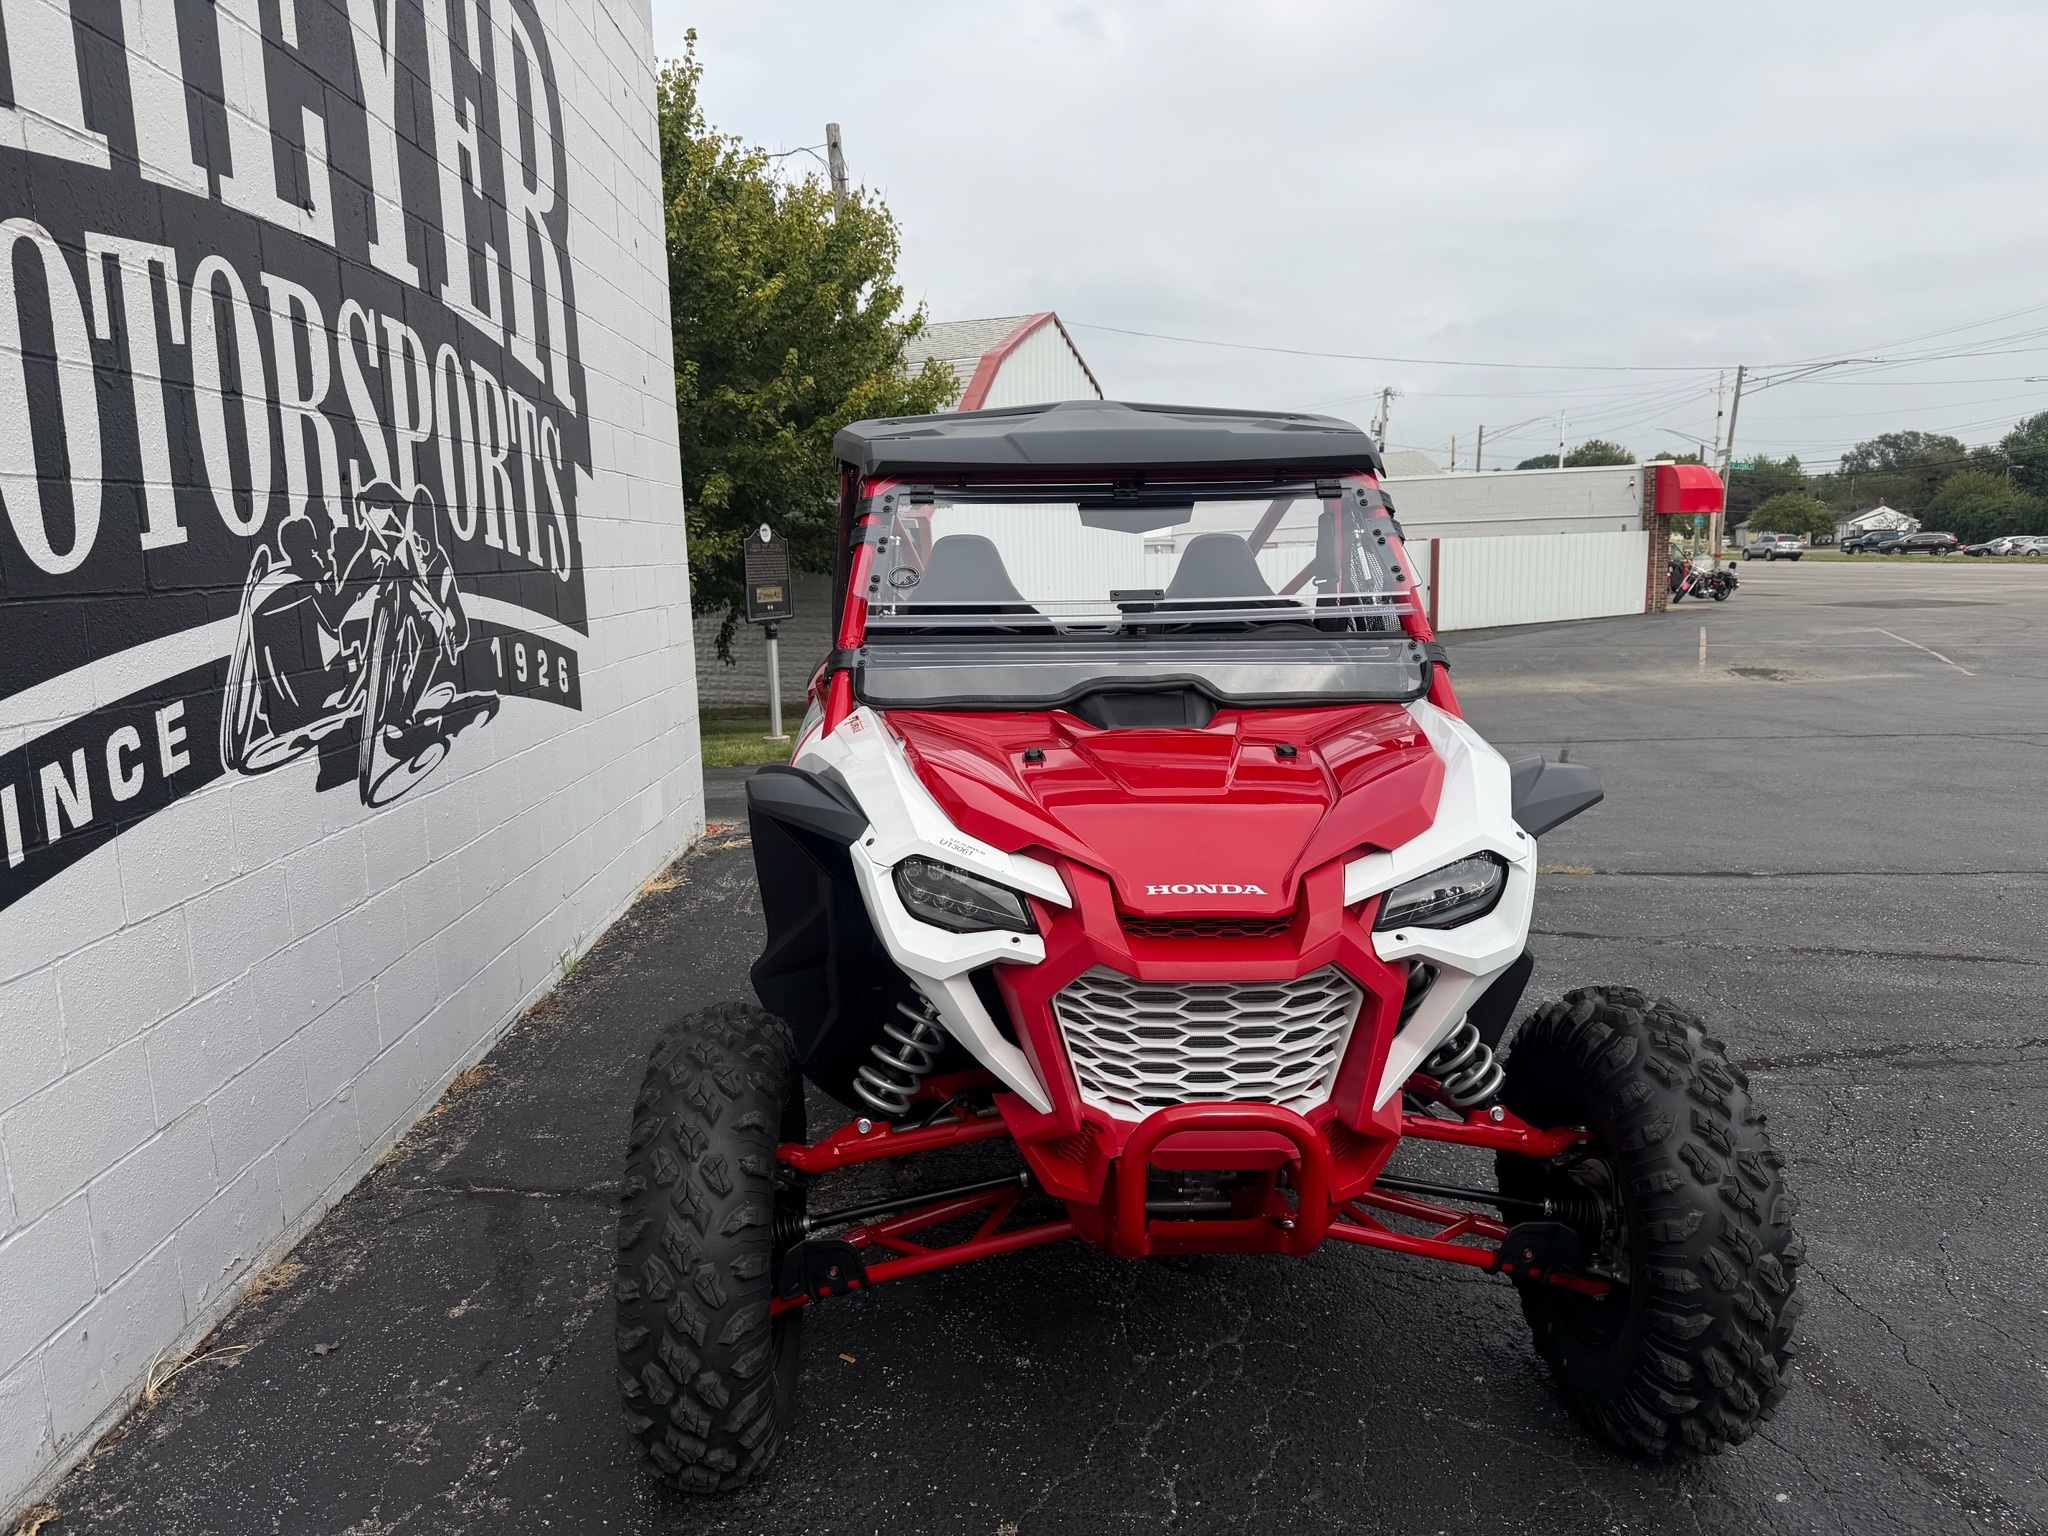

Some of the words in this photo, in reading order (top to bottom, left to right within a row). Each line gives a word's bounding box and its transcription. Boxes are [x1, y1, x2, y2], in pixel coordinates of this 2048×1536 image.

[0, 700, 191, 868] INCE
[490, 637, 569, 693] 1926
[1145, 884, 1269, 896] HONDA
